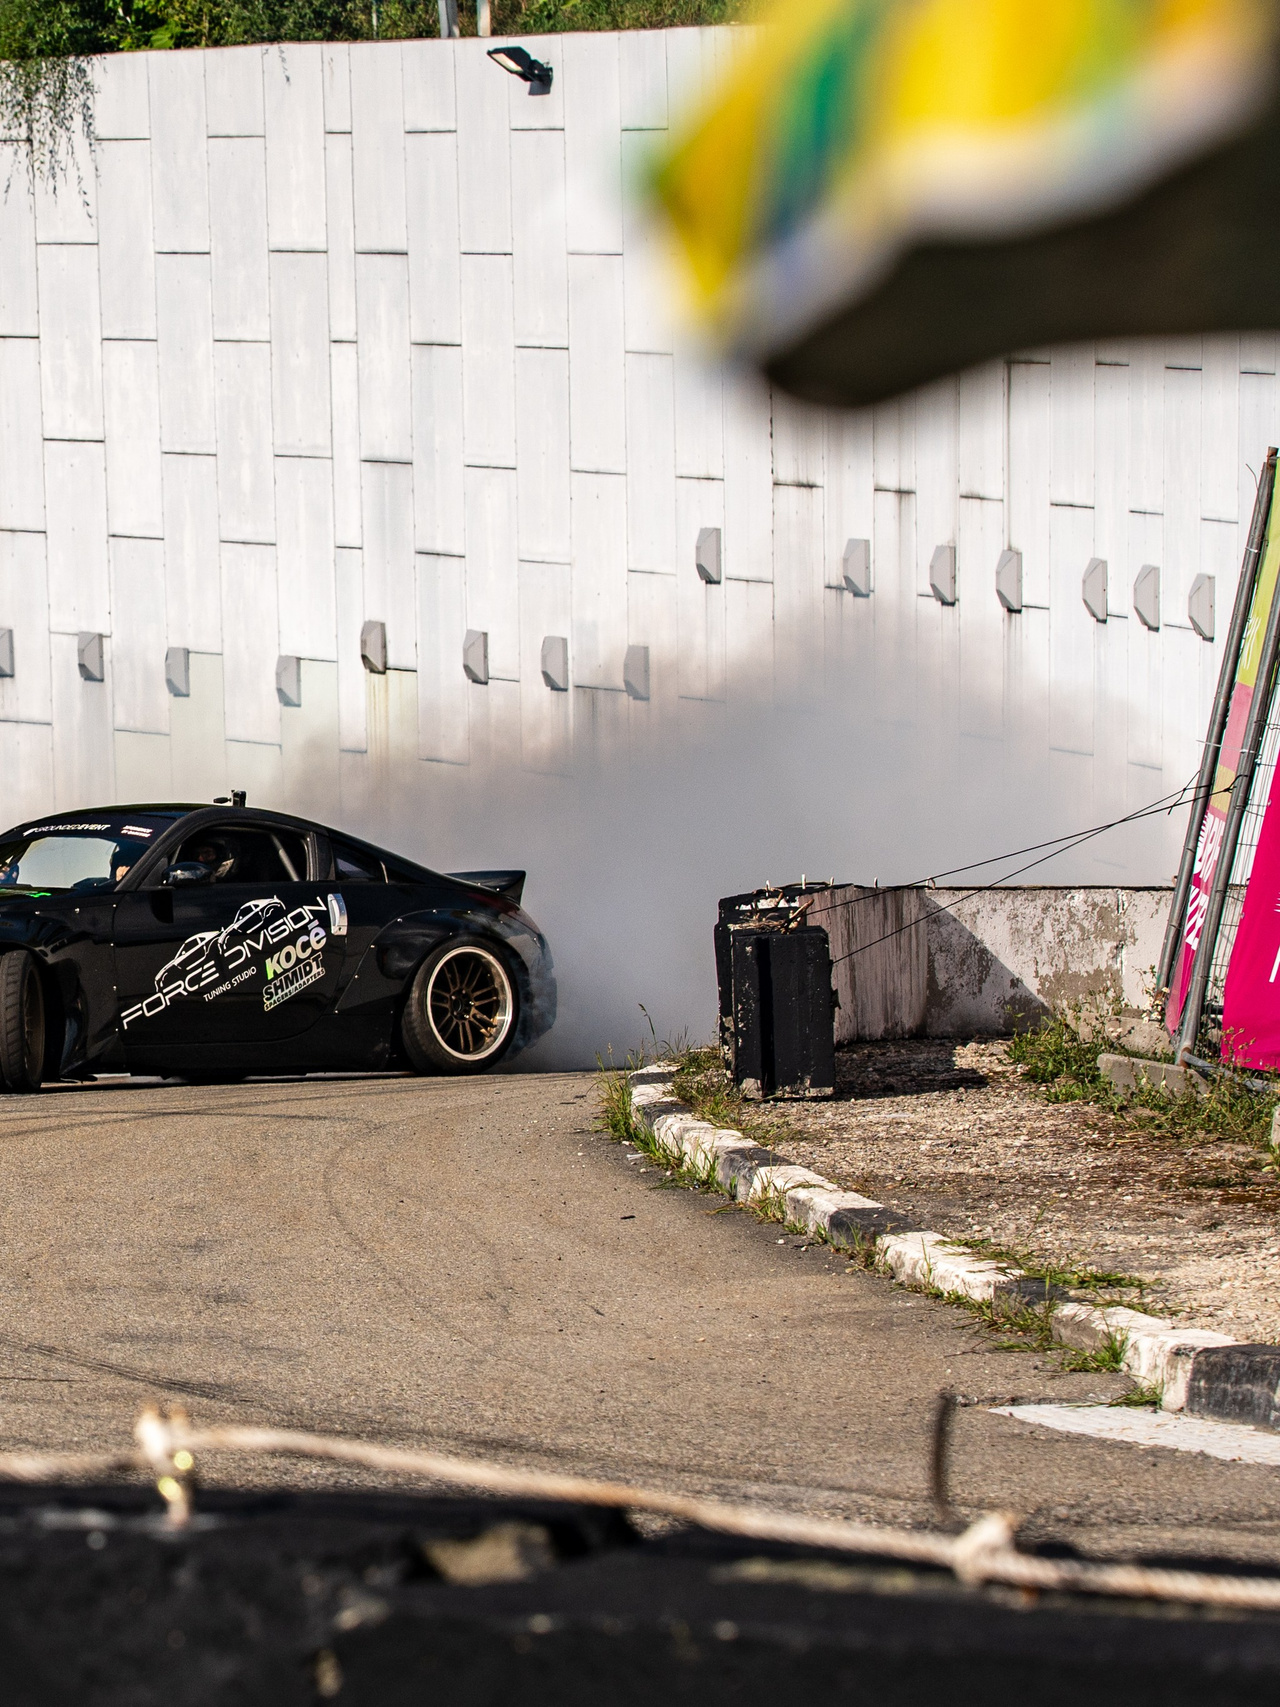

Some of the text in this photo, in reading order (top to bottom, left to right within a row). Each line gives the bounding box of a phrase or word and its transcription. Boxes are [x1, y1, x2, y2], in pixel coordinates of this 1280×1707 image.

[120, 896, 327, 1030] FORCE DIVISION
[203, 966, 258, 1003] TUNING STUDIO
[263, 952, 323, 1002] SHMIDT
